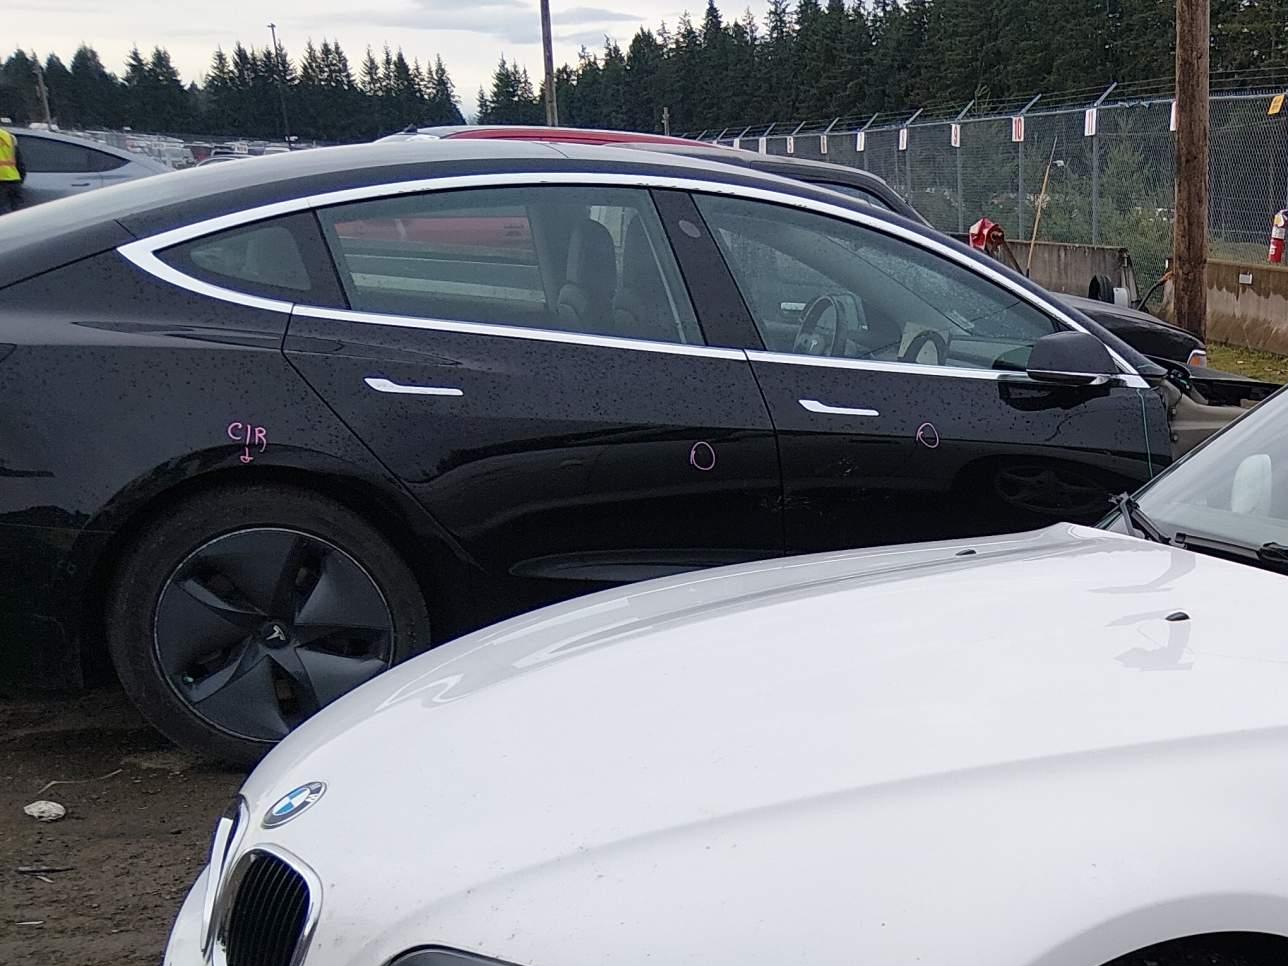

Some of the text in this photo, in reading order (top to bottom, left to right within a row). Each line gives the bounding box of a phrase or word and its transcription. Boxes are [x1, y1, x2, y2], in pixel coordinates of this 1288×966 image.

[1013, 117, 1023, 140] 10
[1087, 110, 1094, 134] 11
[952, 126, 959, 146] 9
